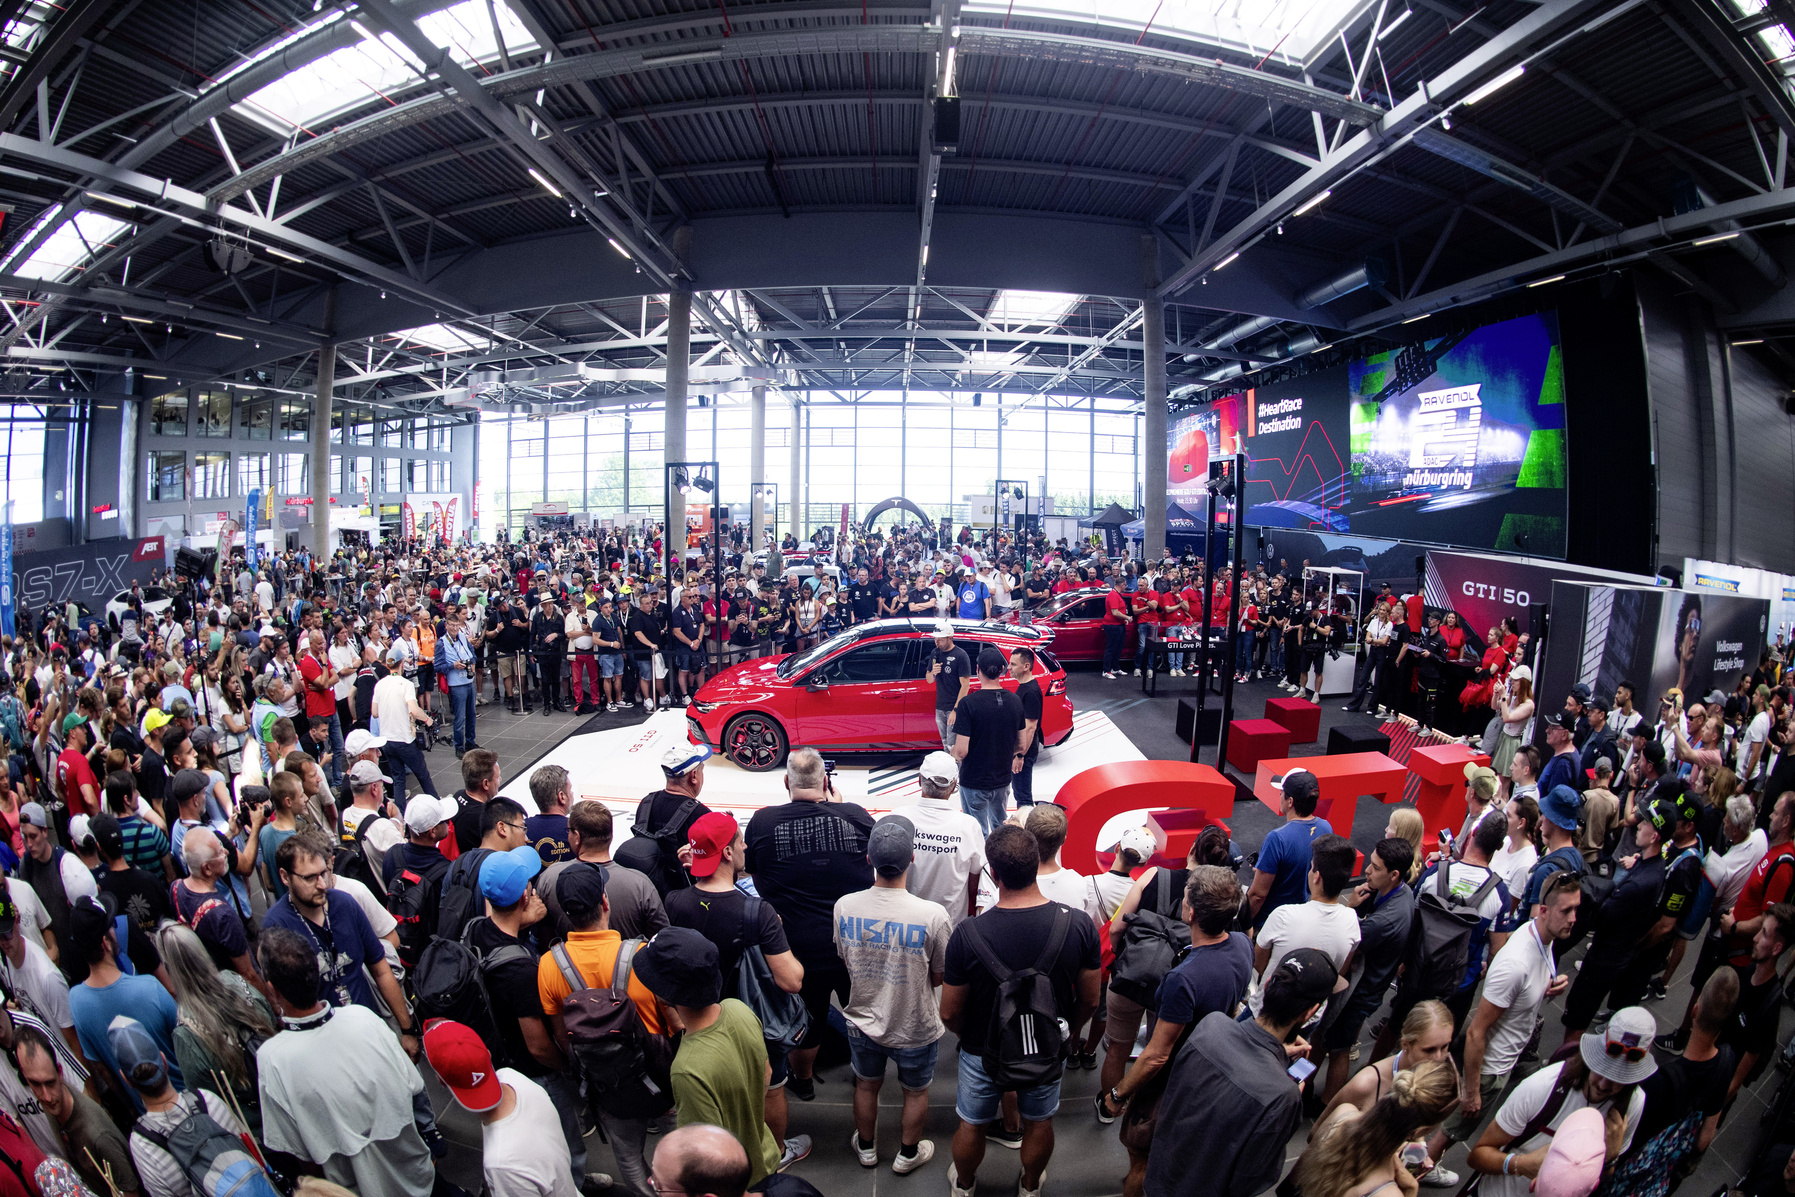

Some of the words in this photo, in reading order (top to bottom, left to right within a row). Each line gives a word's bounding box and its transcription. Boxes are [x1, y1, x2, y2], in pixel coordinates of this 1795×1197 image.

[1424, 391, 1475, 407] RAVENOL
[1257, 398, 1303, 418] #HeartRace
[1258, 415, 1302, 435] Destination
[1423, 457, 1439, 466] ADAC
[1405, 468, 1474, 490] nürburgring
[445, 504, 456, 540] MOTUL
[141, 541, 159, 556] ABT
[1697, 577, 1737, 592] RAVENOL
[1462, 581, 1497, 600] GTI
[1503, 588, 1530, 607] 50
[1716, 640, 1743, 654] Volkswagen
[1713, 659, 1733, 672] Lifestyle
[1734, 657, 1745, 671] Shop
[1053, 743, 1491, 882] GTI
[915, 829, 962, 844] kswagen
[551, 847, 571, 856] EDITION
[913, 842, 958, 855] otorsport
[840, 915, 927, 949] NISMO
[869, 942, 899, 953] RACING
[900, 946, 924, 956] TEAM
[17, 1096, 45, 1115] adi
